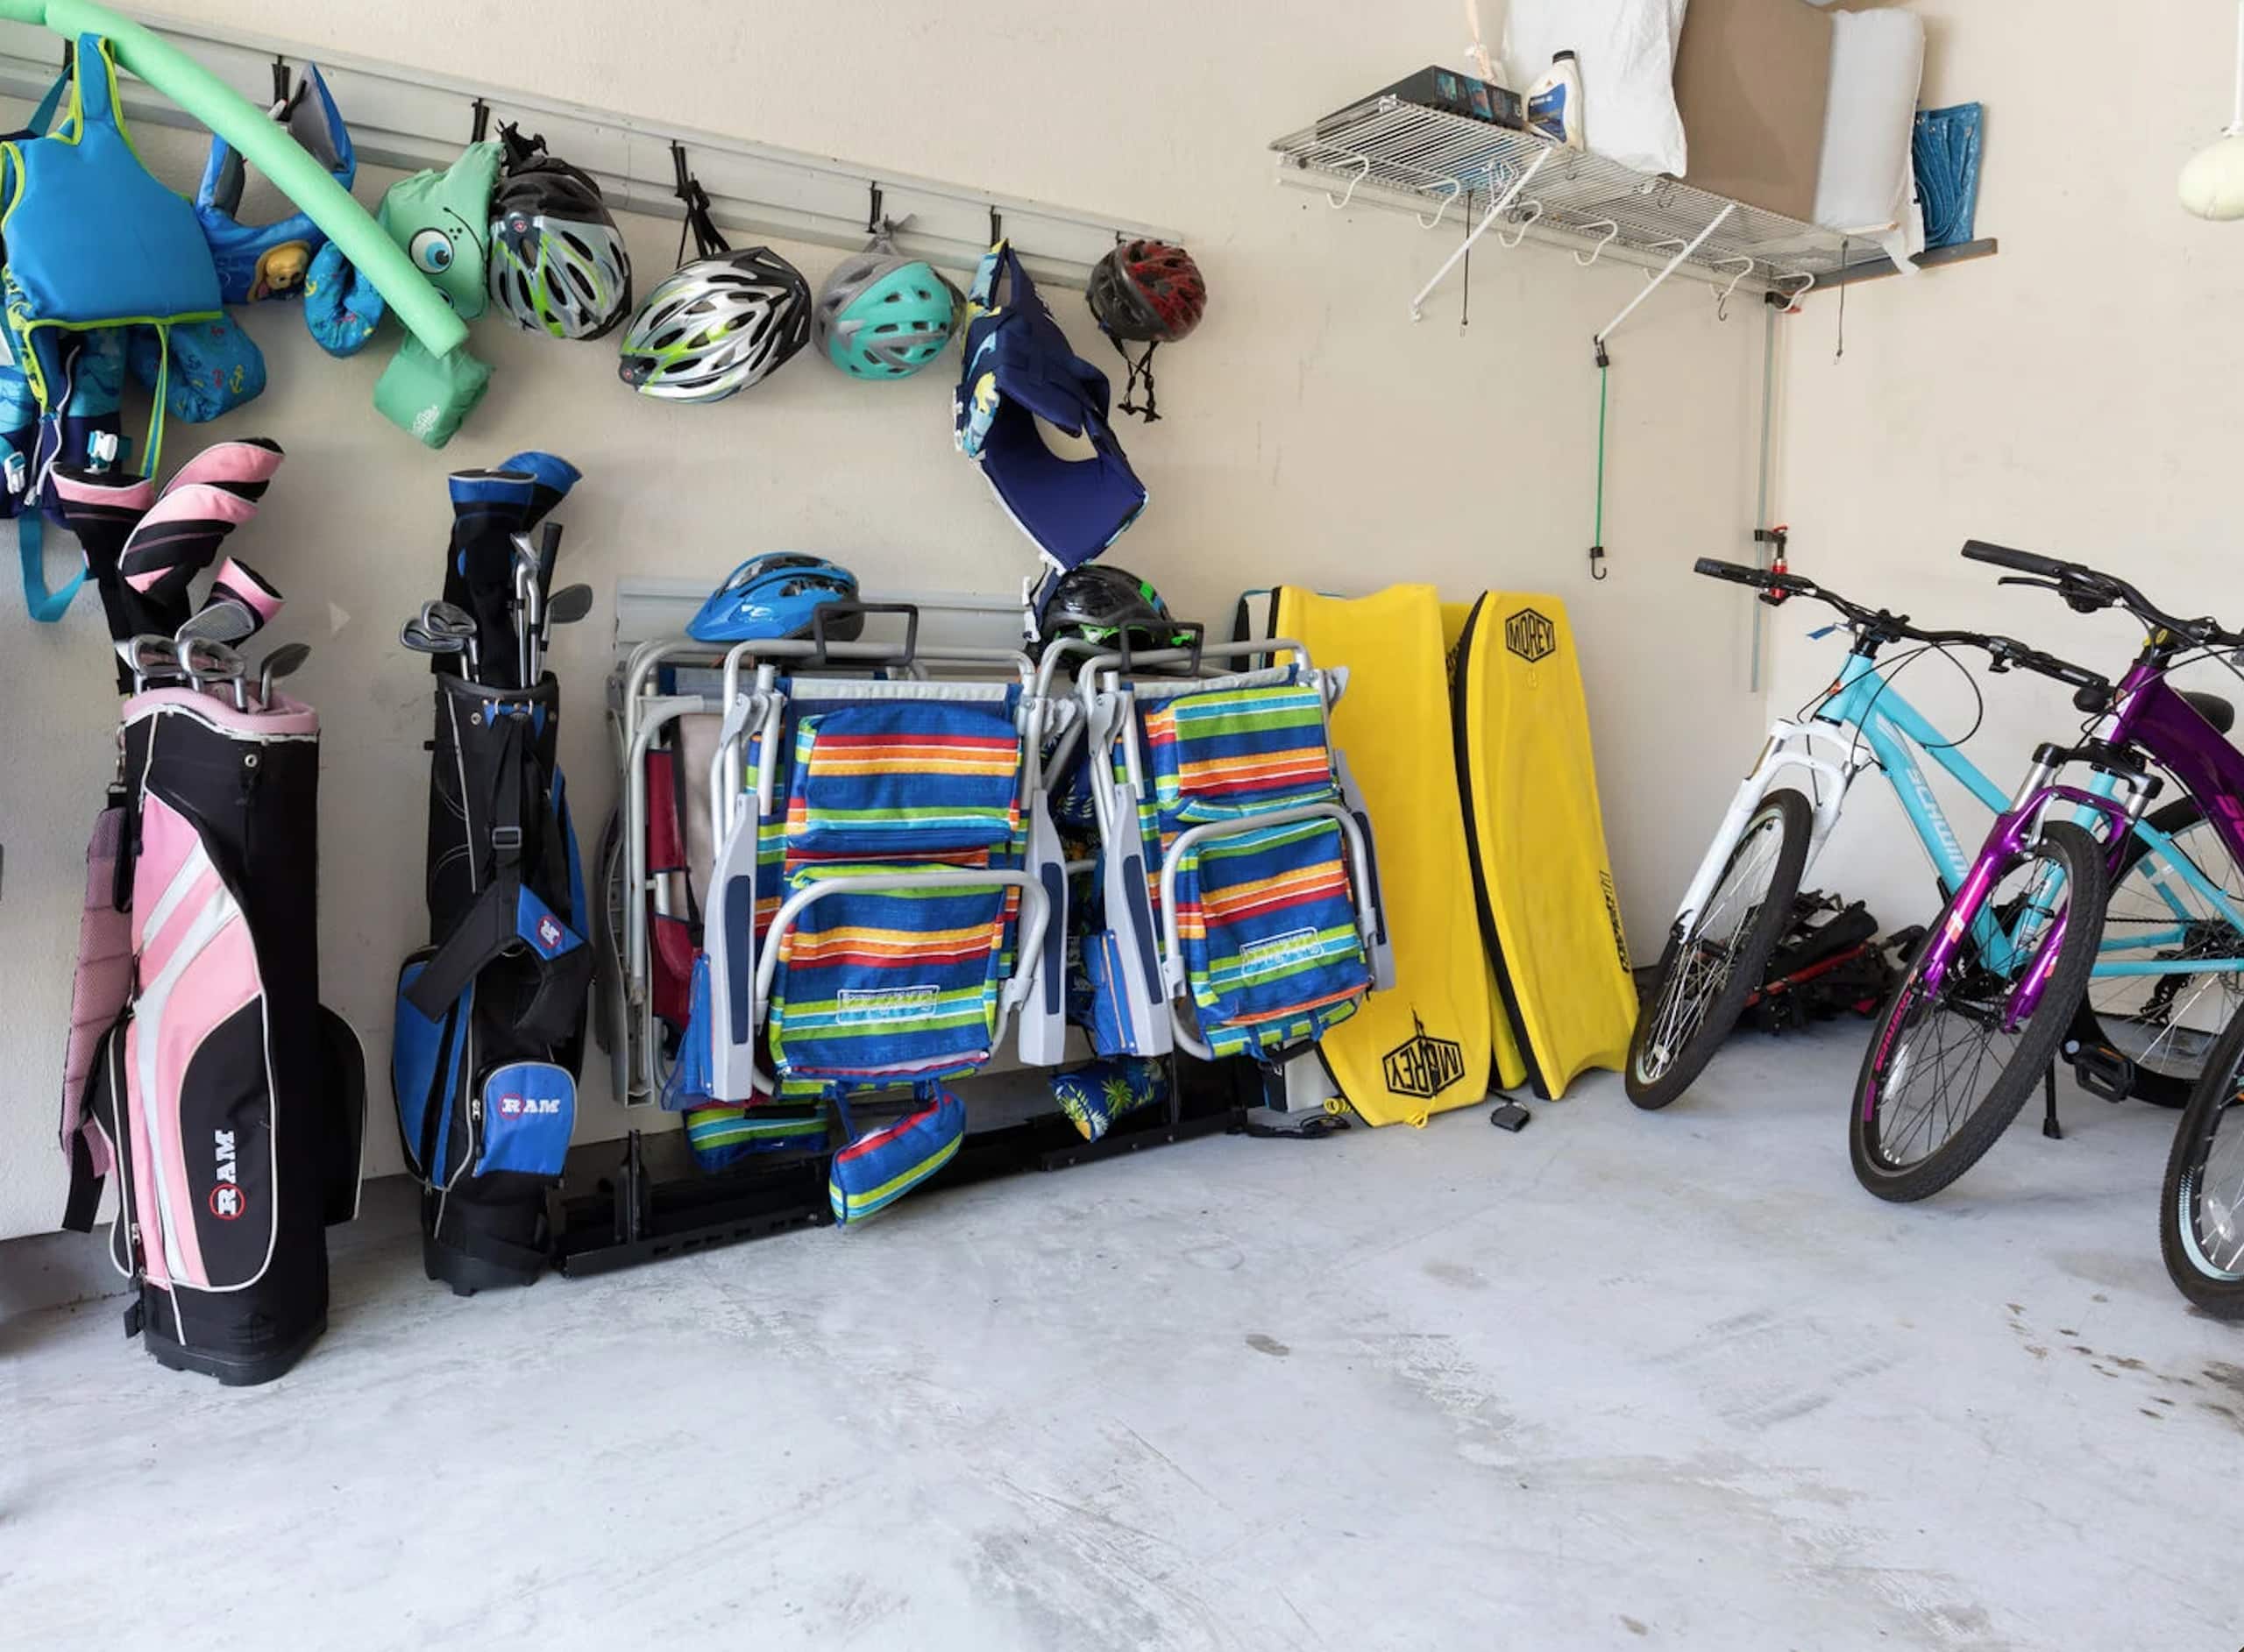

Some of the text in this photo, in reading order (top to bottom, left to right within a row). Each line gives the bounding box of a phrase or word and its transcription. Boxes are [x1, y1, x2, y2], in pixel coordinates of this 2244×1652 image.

[1508, 613, 1552, 657] MOREY
[1906, 768, 1971, 880] SCHWIN
[1390, 1039, 1459, 1093] MOREY
[501, 1097, 561, 1115] RAM
[214, 1128, 238, 1216] RAM
